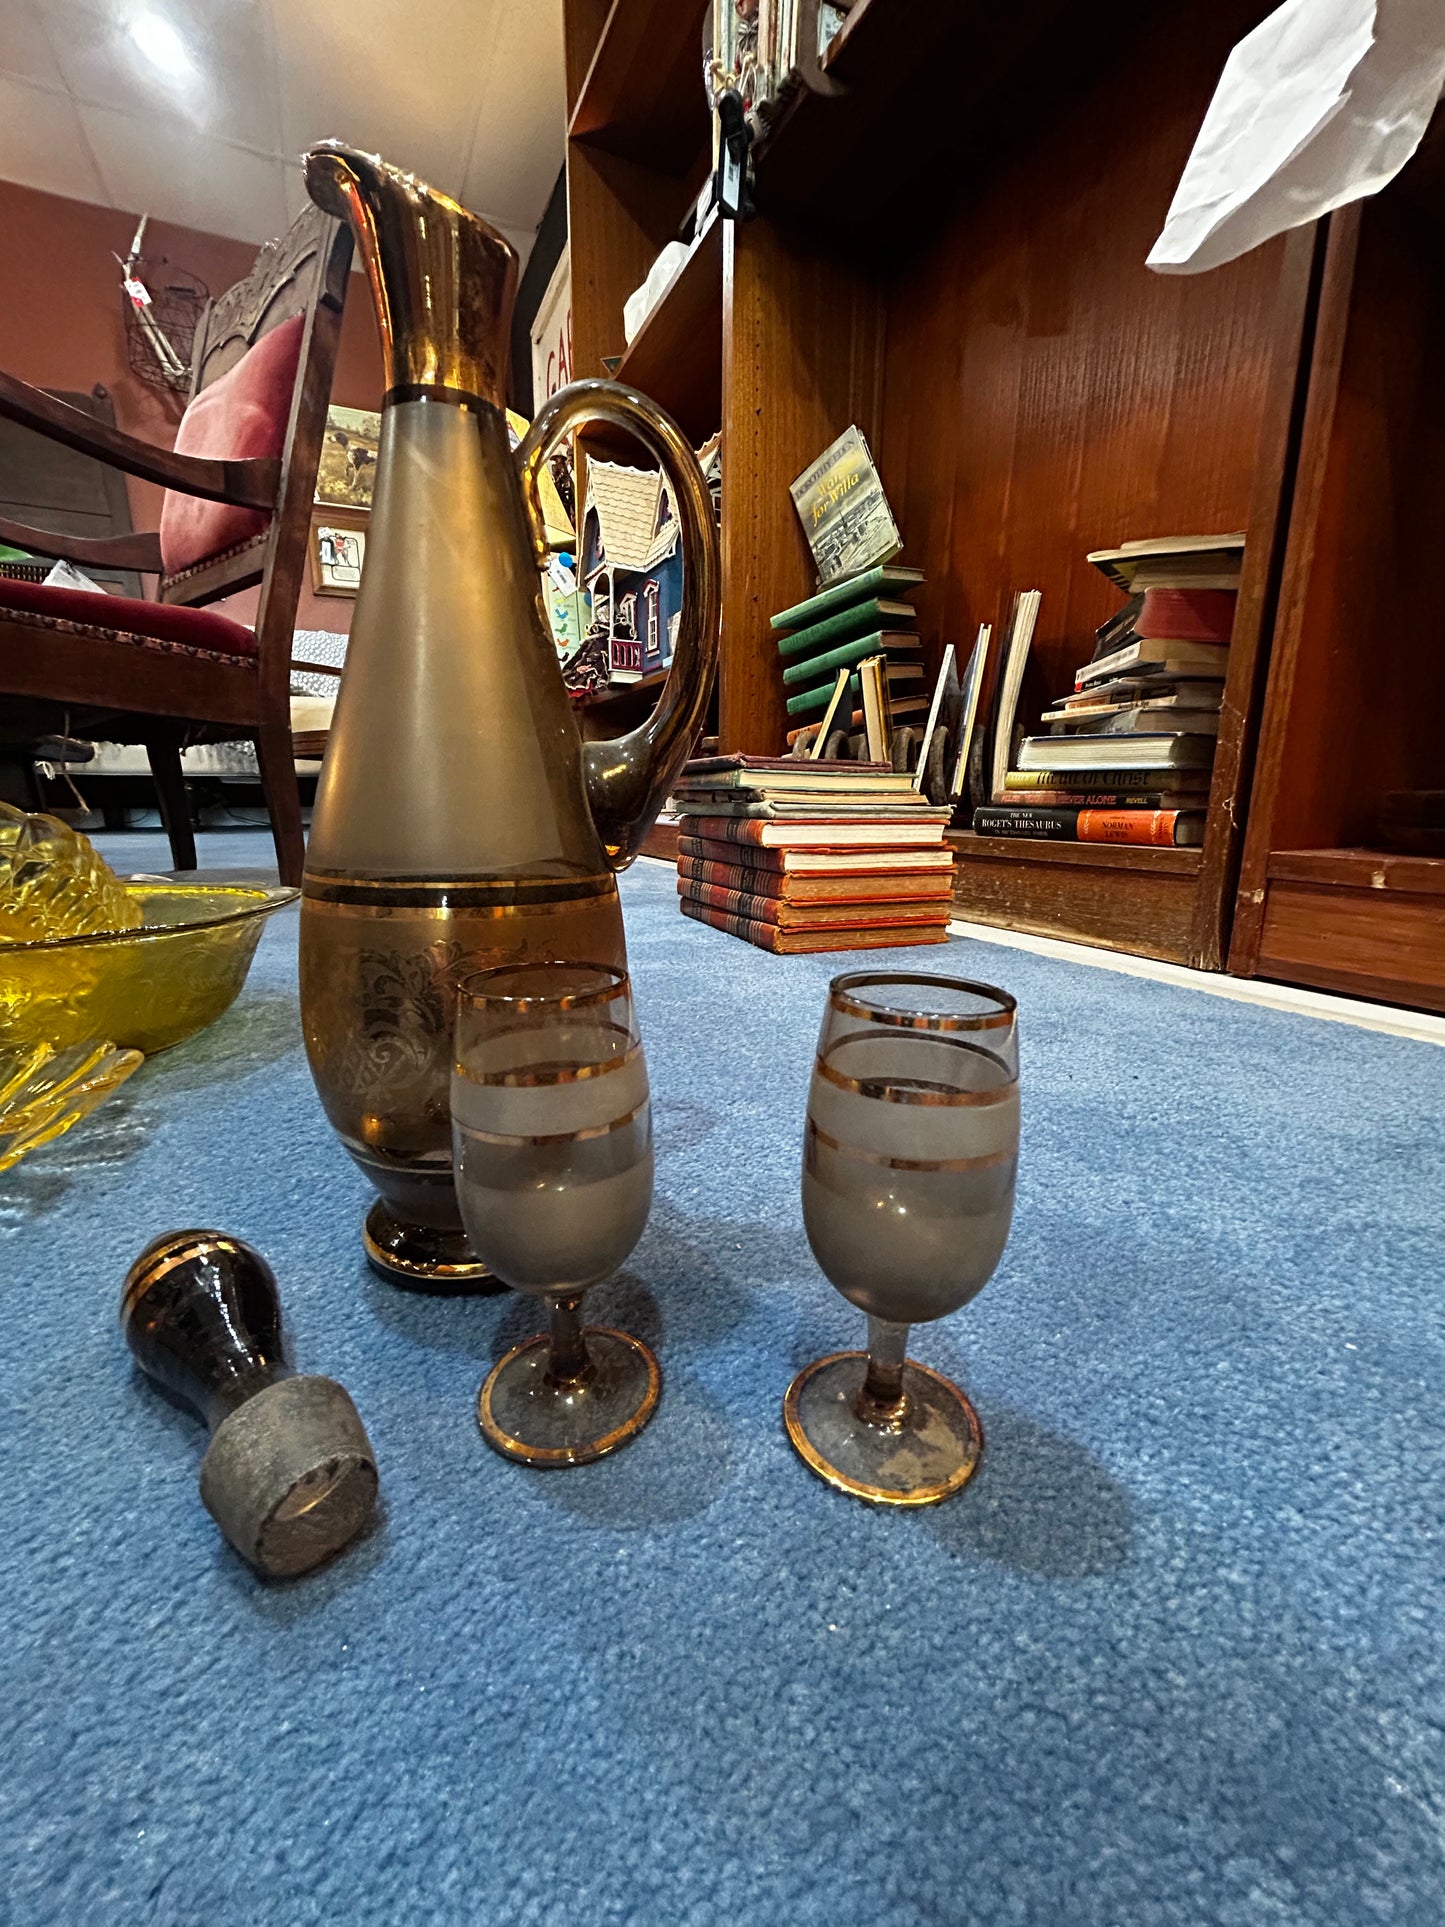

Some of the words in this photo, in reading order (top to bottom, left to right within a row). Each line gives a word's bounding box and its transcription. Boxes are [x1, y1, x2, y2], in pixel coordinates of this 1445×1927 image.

[794, 458, 833, 499] DOROTHY
[812, 502, 829, 527] for
[830, 472, 860, 504] Willa
[1105, 771, 1151, 785] Christ
[1085, 795, 1117, 805] ALONE
[981, 818, 1012, 828] ROGET'S
[1013, 819, 1062, 830] THESAURUS
[1102, 821, 1134, 830] NORMAN
[1104, 830, 1128, 838] LEWIS
